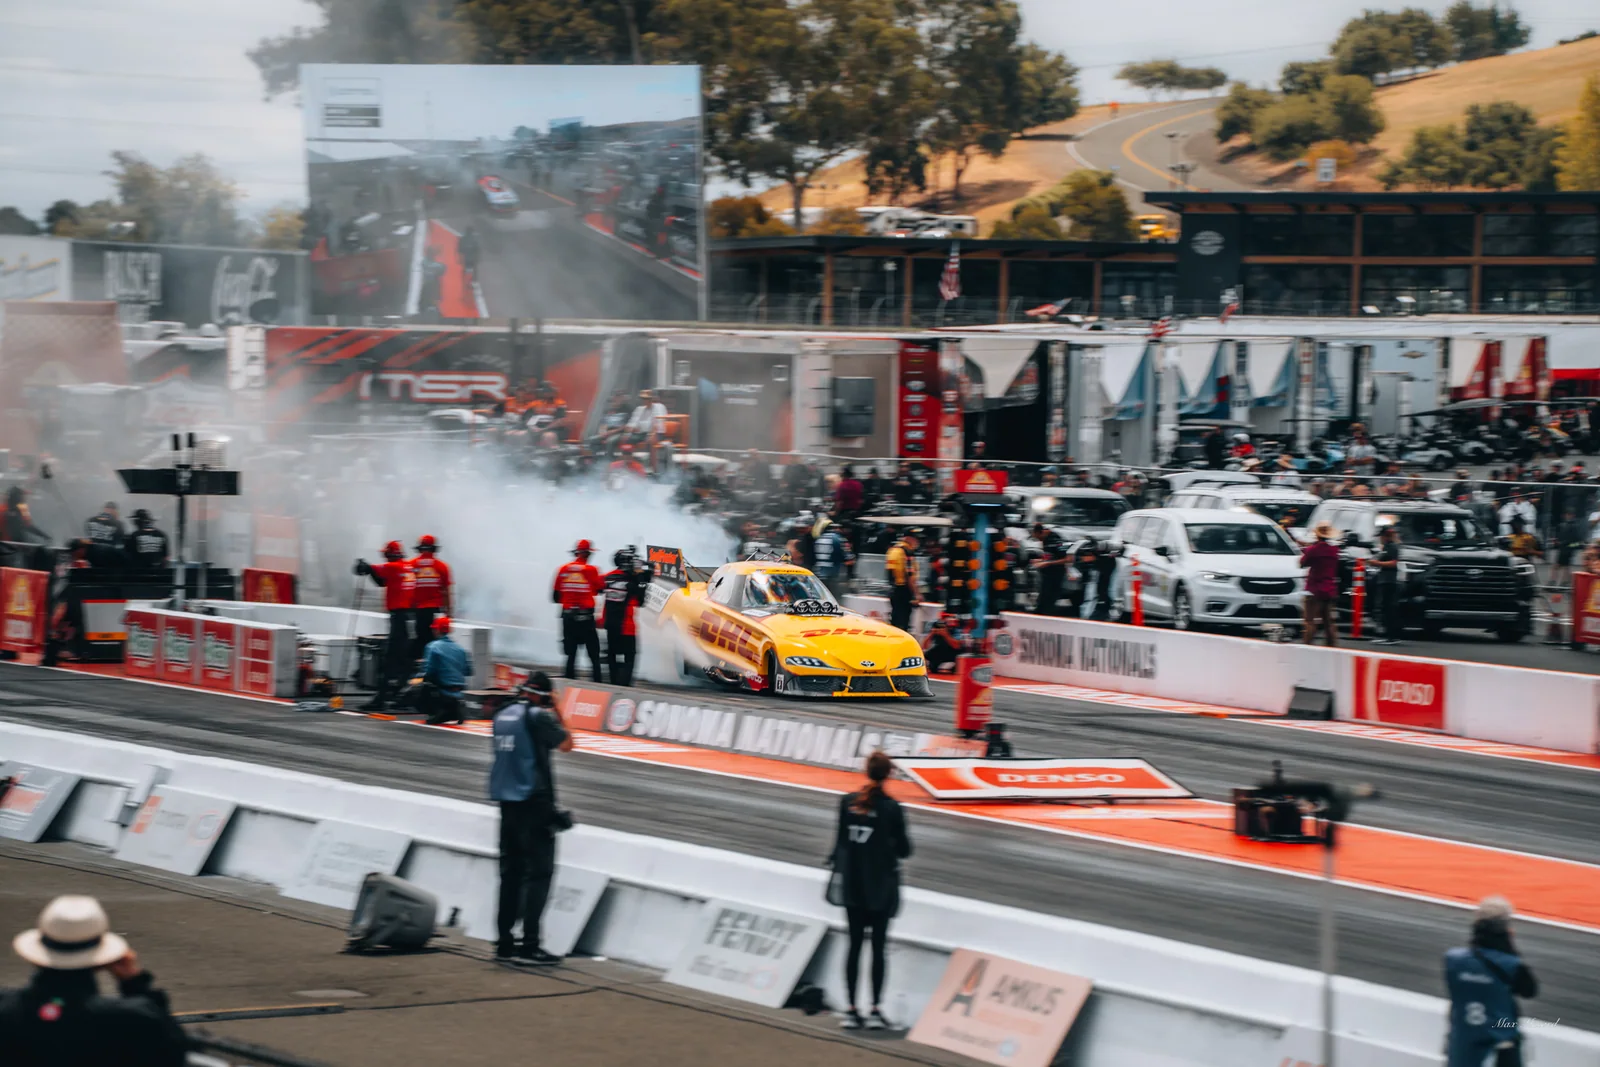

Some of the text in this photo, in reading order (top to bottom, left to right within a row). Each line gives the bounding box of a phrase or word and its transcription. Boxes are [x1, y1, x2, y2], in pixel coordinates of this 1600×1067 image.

[701, 610, 753, 661] DHL
[800, 628, 887, 638] DHL
[1379, 679, 1435, 706] DENSO
[632, 700, 738, 749] SONOMA
[997, 772, 1126, 785] DENSO
[704, 907, 811, 960] FENDT
